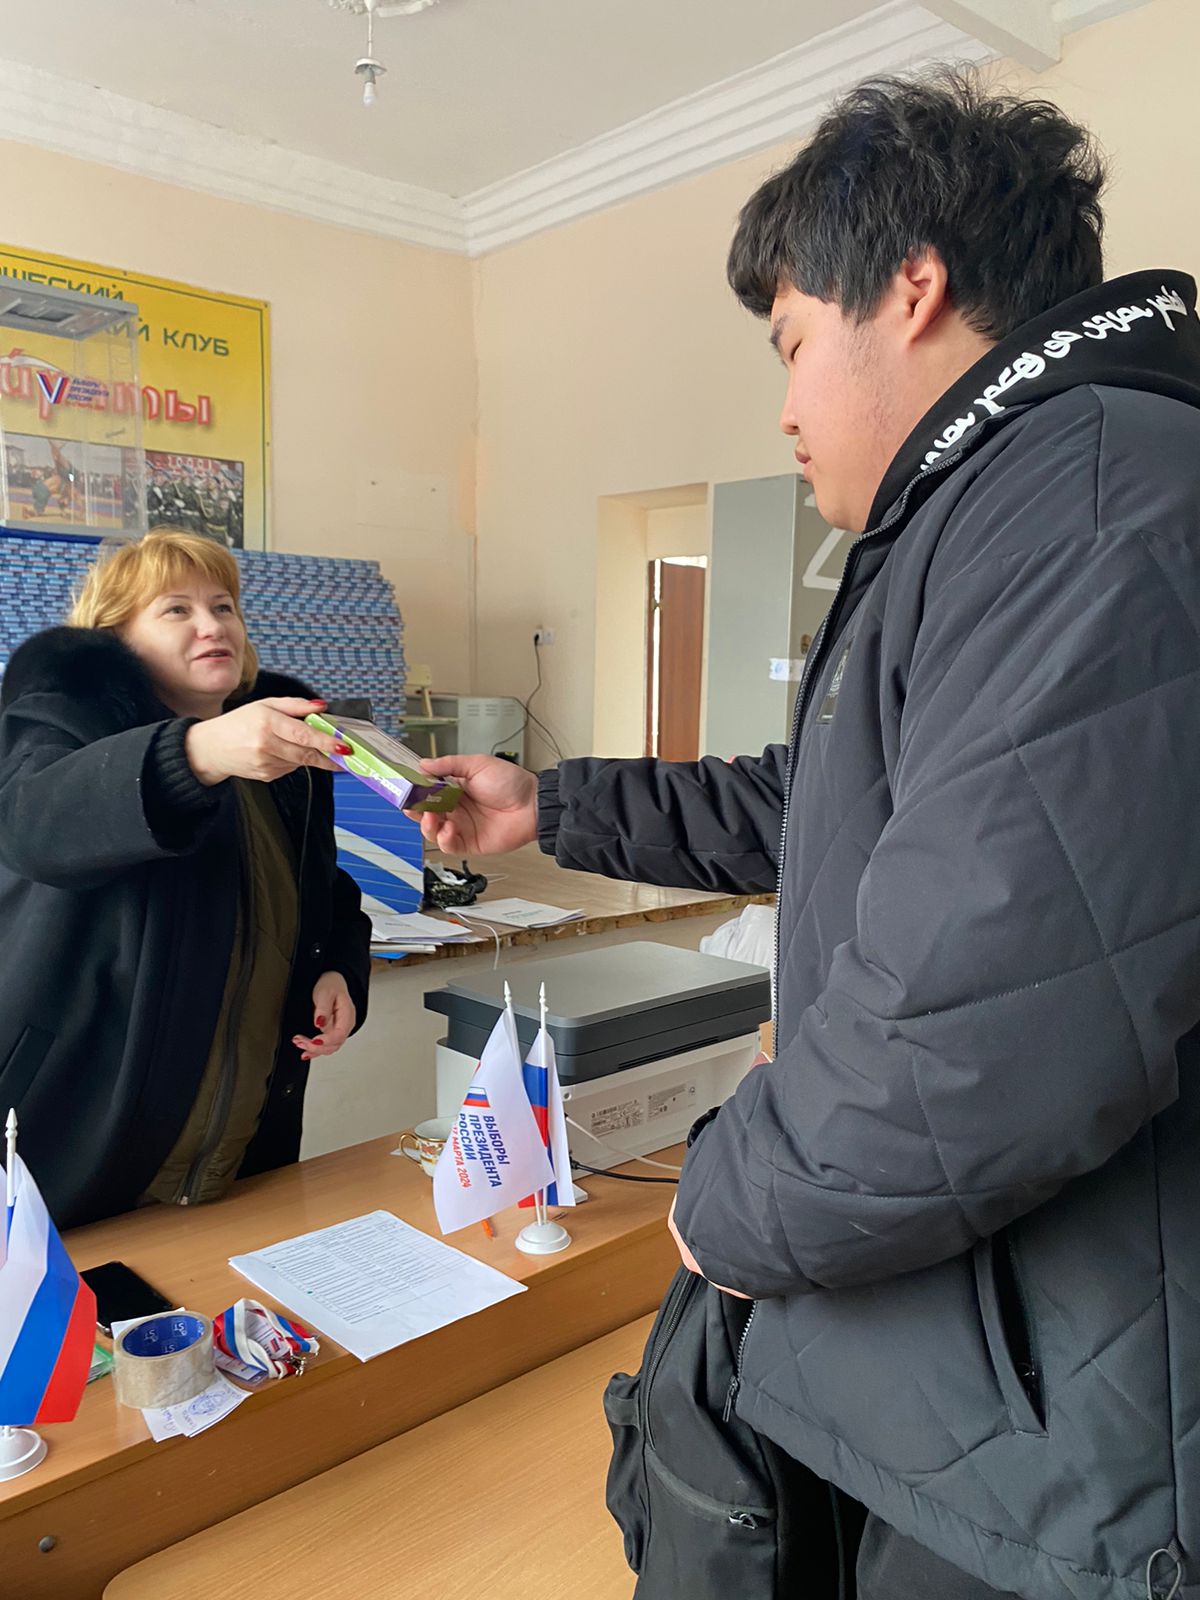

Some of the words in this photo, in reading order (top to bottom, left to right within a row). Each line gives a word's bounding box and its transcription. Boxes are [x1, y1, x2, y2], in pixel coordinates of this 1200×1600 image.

[163, 327, 230, 357] КЛУБ
[452, 1136, 464, 1166] МАРТА
[459, 1114, 477, 1160] РОССИИ
[469, 1114, 502, 1187] ПРЕЗИДЕНТА
[483, 1115, 510, 1165] ВЫБОРЫ
[457, 1168, 472, 1188] 2024
